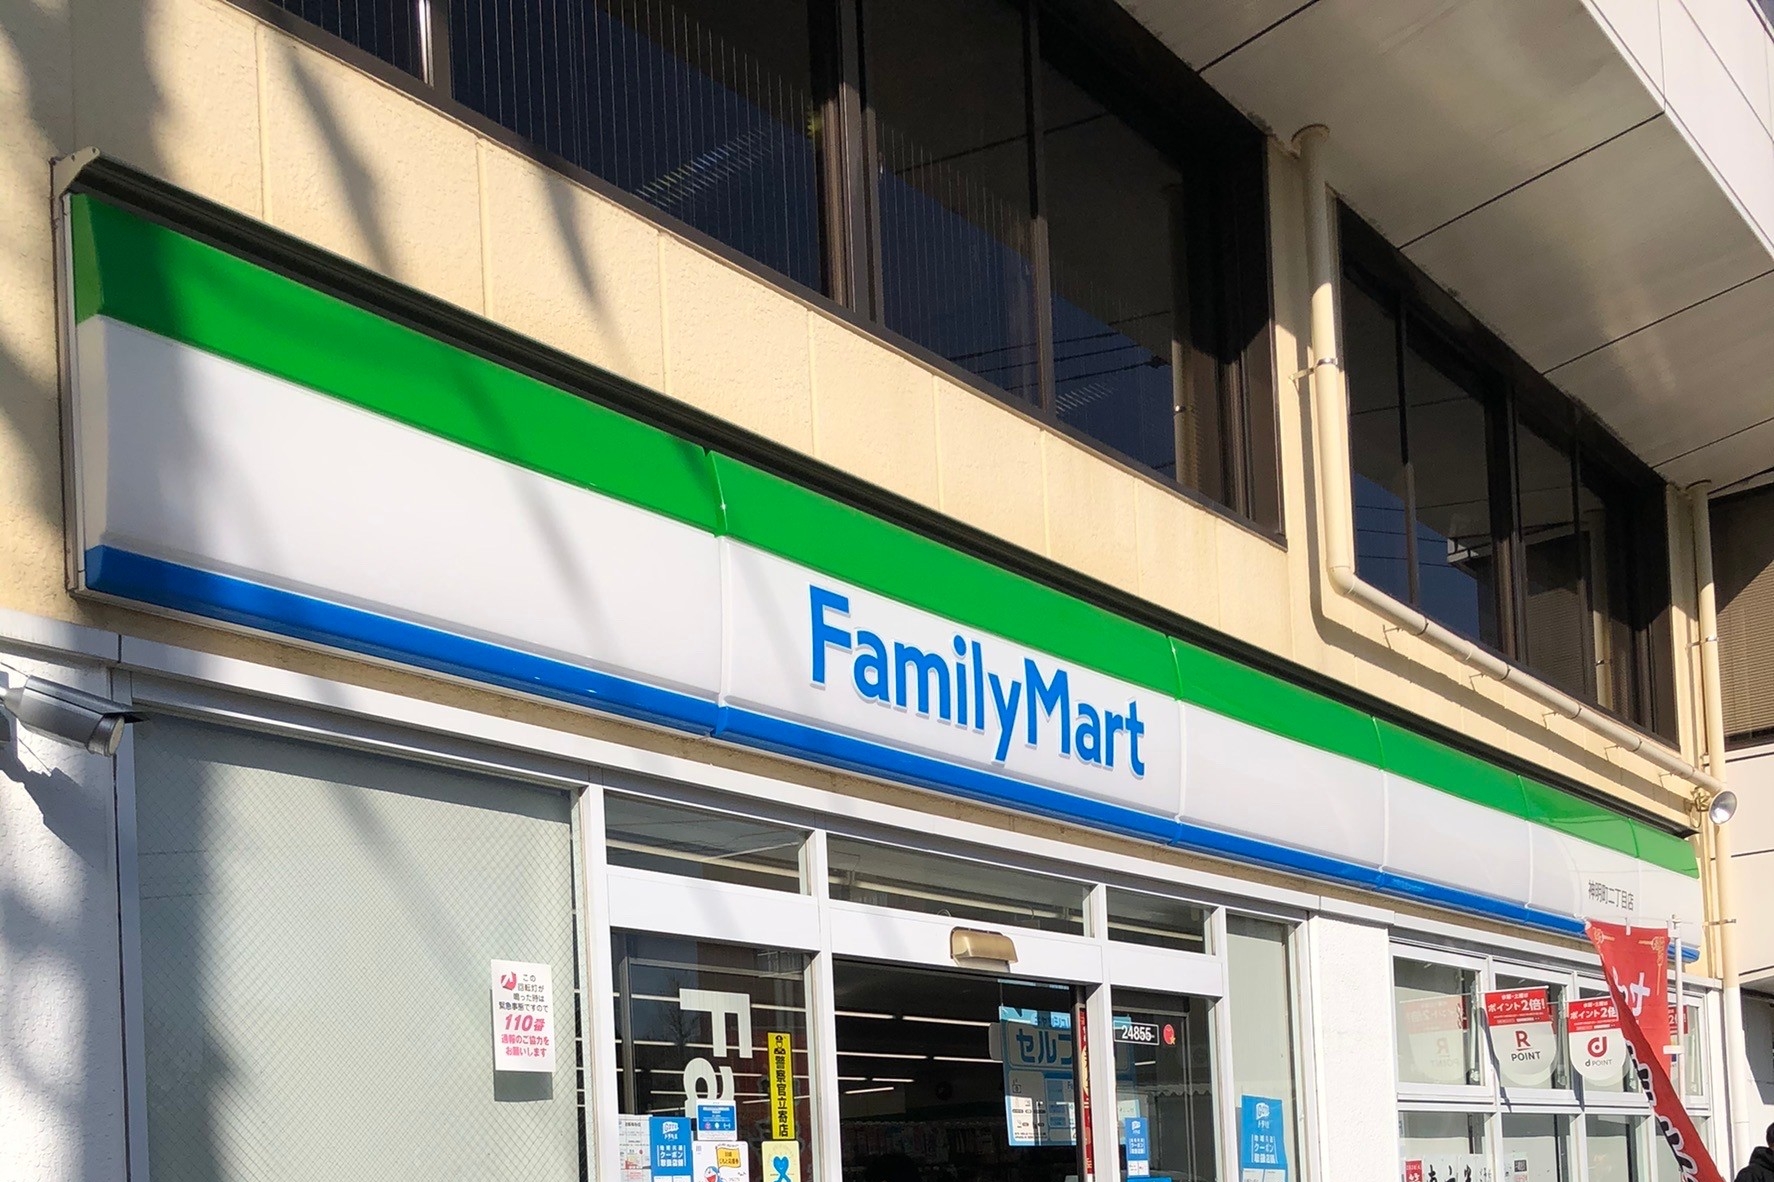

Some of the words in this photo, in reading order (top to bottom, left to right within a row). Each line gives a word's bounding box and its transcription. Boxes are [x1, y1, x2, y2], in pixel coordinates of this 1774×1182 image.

[808, 583, 1146, 778] FamilyMart
[522, 973, 537, 983] この
[517, 983, 545, 993] 回転灯が
[1488, 998, 1546, 1013] ポイント2倍!
[504, 1013, 546, 1032] 110番
[501, 1033, 550, 1046] 通報のご協力を
[505, 1046, 548, 1058] お願いします
[1511, 1051, 1541, 1062] POINT
[1591, 1059, 1613, 1067] POINT
[774, 1055, 790, 1138] 警察官立寄店
